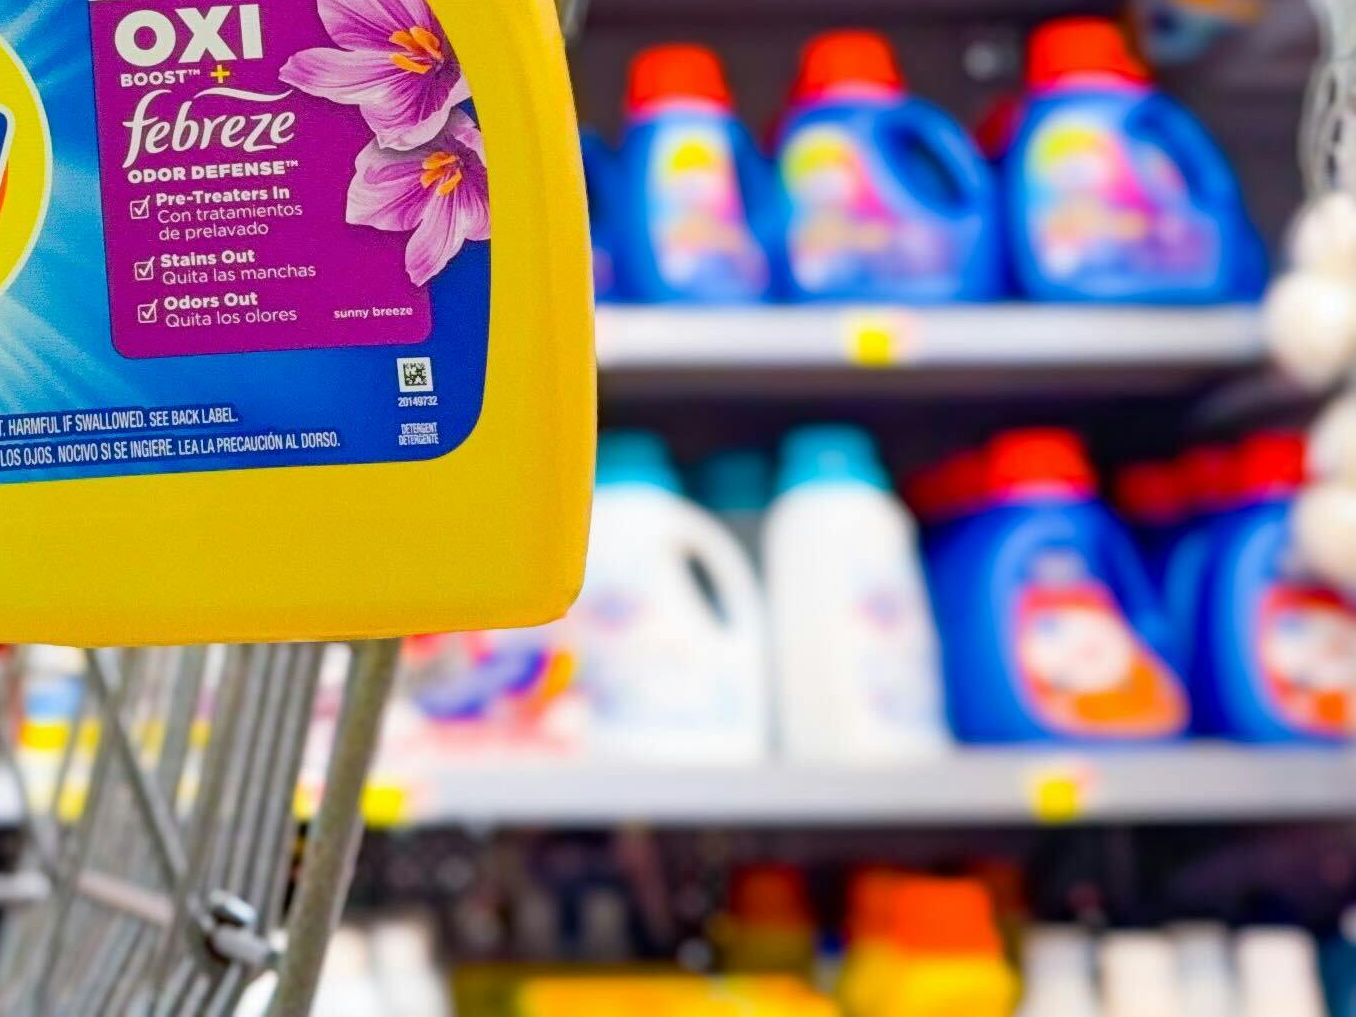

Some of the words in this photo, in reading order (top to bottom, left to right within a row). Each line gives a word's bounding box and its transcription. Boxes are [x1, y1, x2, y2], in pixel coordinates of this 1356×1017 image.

[114, 4, 263, 67] OXI
[122, 88, 296, 169] febreze
[127, 166, 186, 184] ODOR
[155, 188, 268, 207] Pre-Treaters
[272, 186, 290, 200] In
[157, 209, 191, 224] Con
[196, 204, 303, 222] tratamientos
[159, 226, 180, 241] de
[185, 221, 269, 242] prelavado
[160, 251, 217, 268] Stains
[221, 250, 255, 264] Out
[162, 270, 208, 285] Quita
[213, 268, 236, 281] las
[241, 264, 316, 280] manchas
[163, 294, 220, 311] Odors
[223, 292, 258, 307] Out
[165, 312, 212, 328] Quita
[216, 310, 241, 325] los
[245, 308, 298, 323] olores
[333, 308, 369, 320] sunny
[372, 306, 413, 317] breeze
[397, 396, 439, 407] 20149732
[8, 416, 61, 437] HARMFUL
[63, 415, 73, 432] IF
[75, 410, 147, 431] SWALLOWED.
[149, 409, 169, 427] SEE
[172, 408, 200, 426] BACK
[201, 407, 238, 423] LABEL.
[0, 448, 21, 467] LOS
[24, 446, 56, 465] OJOS.
[58, 443, 98, 463] NOCIVO
[100, 442, 111, 460] SI
[114, 441, 128, 459] SE
[130, 438, 176, 458] INGIERE.
[178, 439, 198, 456] LEA
[200, 437, 215, 454] LA
[217, 432, 284, 454] PRECAUCIÓN
[285, 433, 300, 450] AL
[301, 431, 341, 448] DORSO.
